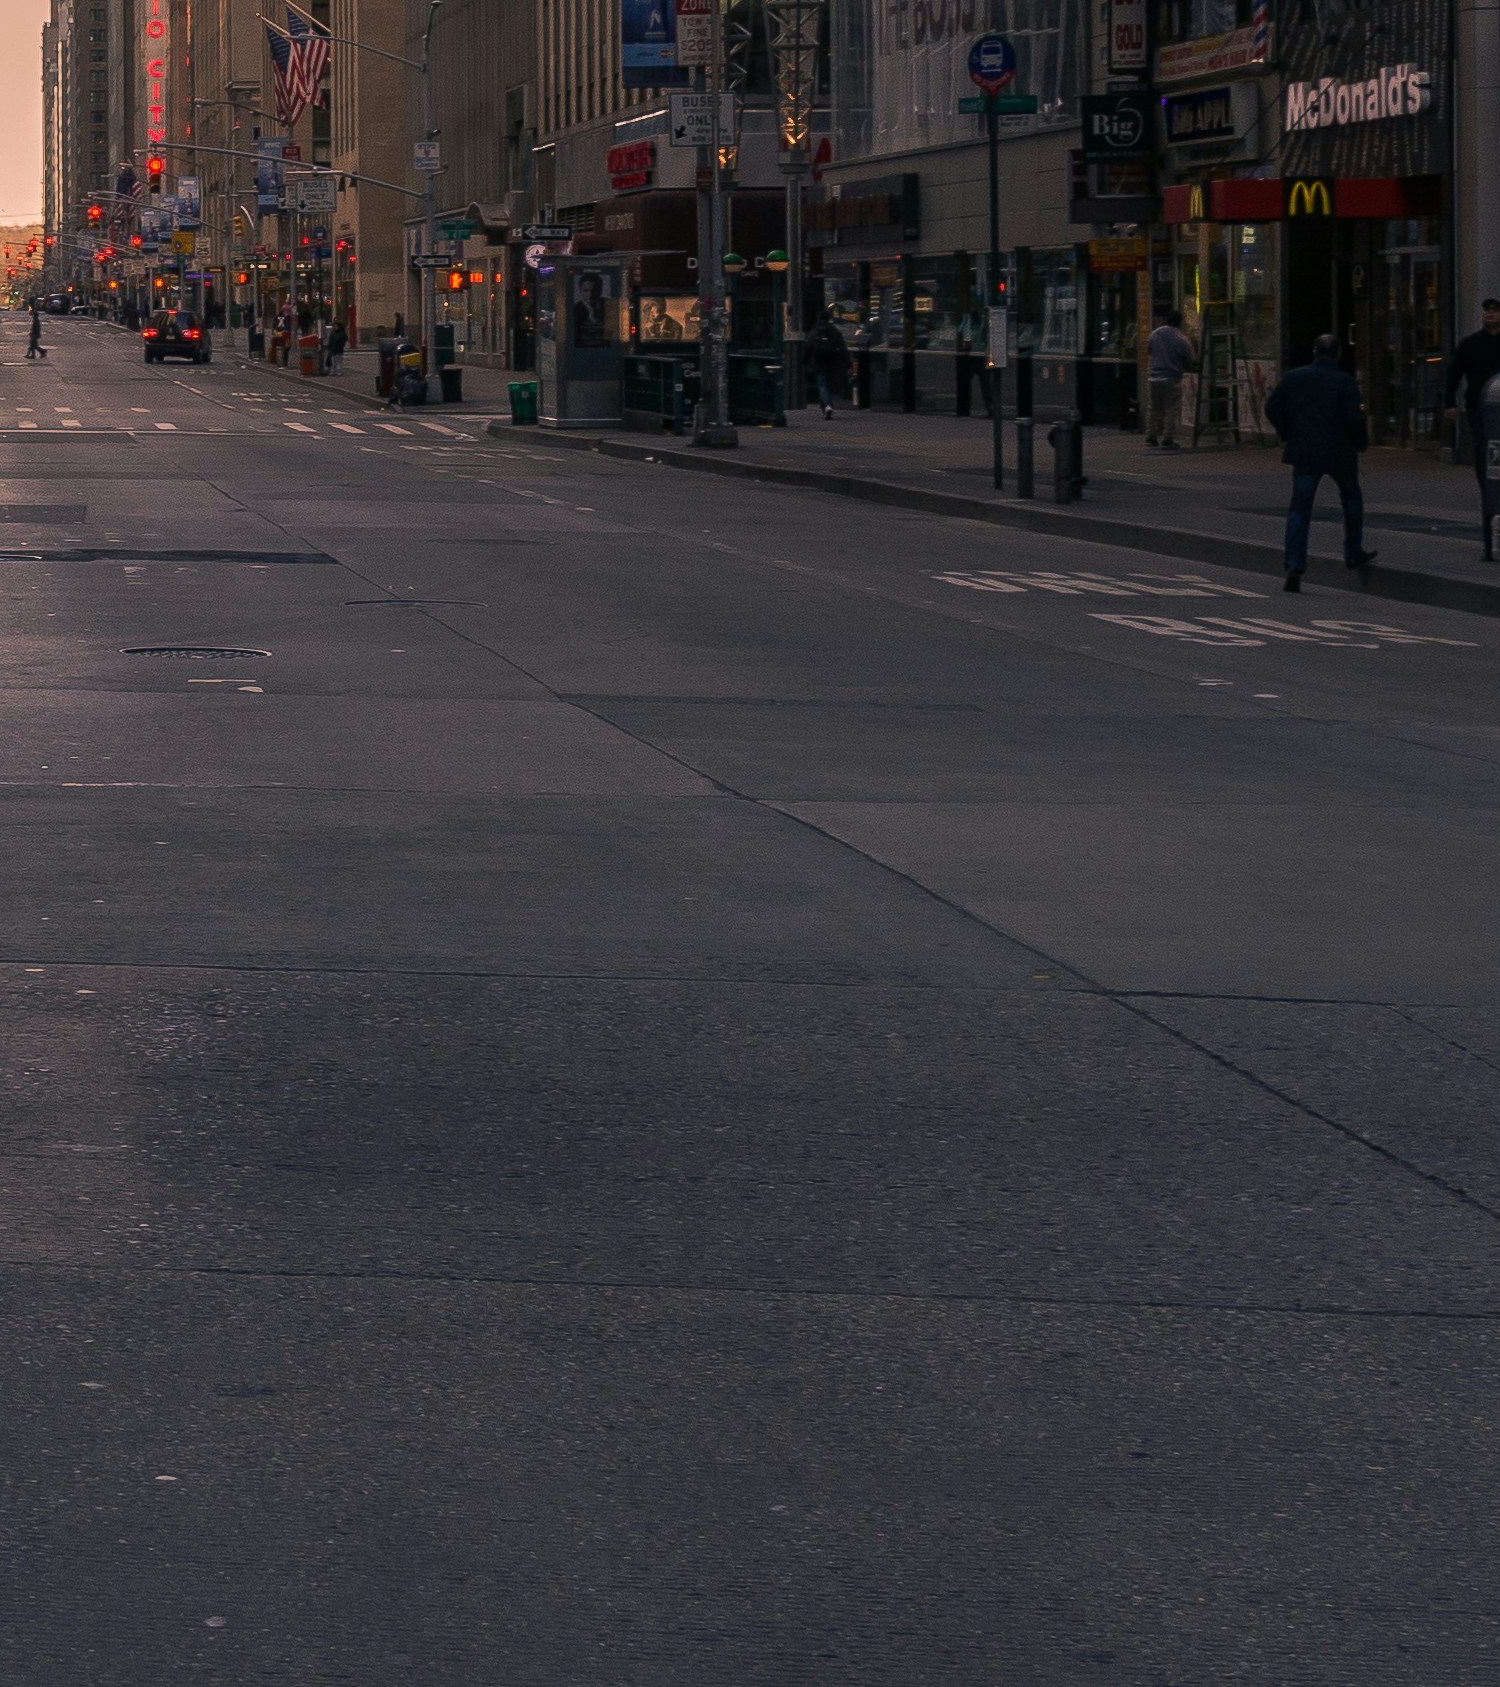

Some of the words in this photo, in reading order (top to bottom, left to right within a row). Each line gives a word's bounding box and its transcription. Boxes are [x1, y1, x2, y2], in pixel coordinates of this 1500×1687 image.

[1115, 24, 1143, 51] GOLD
[147, 60, 166, 143] CITY
[1285, 62, 1432, 132] McDonald's
[1092, 111, 1136, 141] Big
